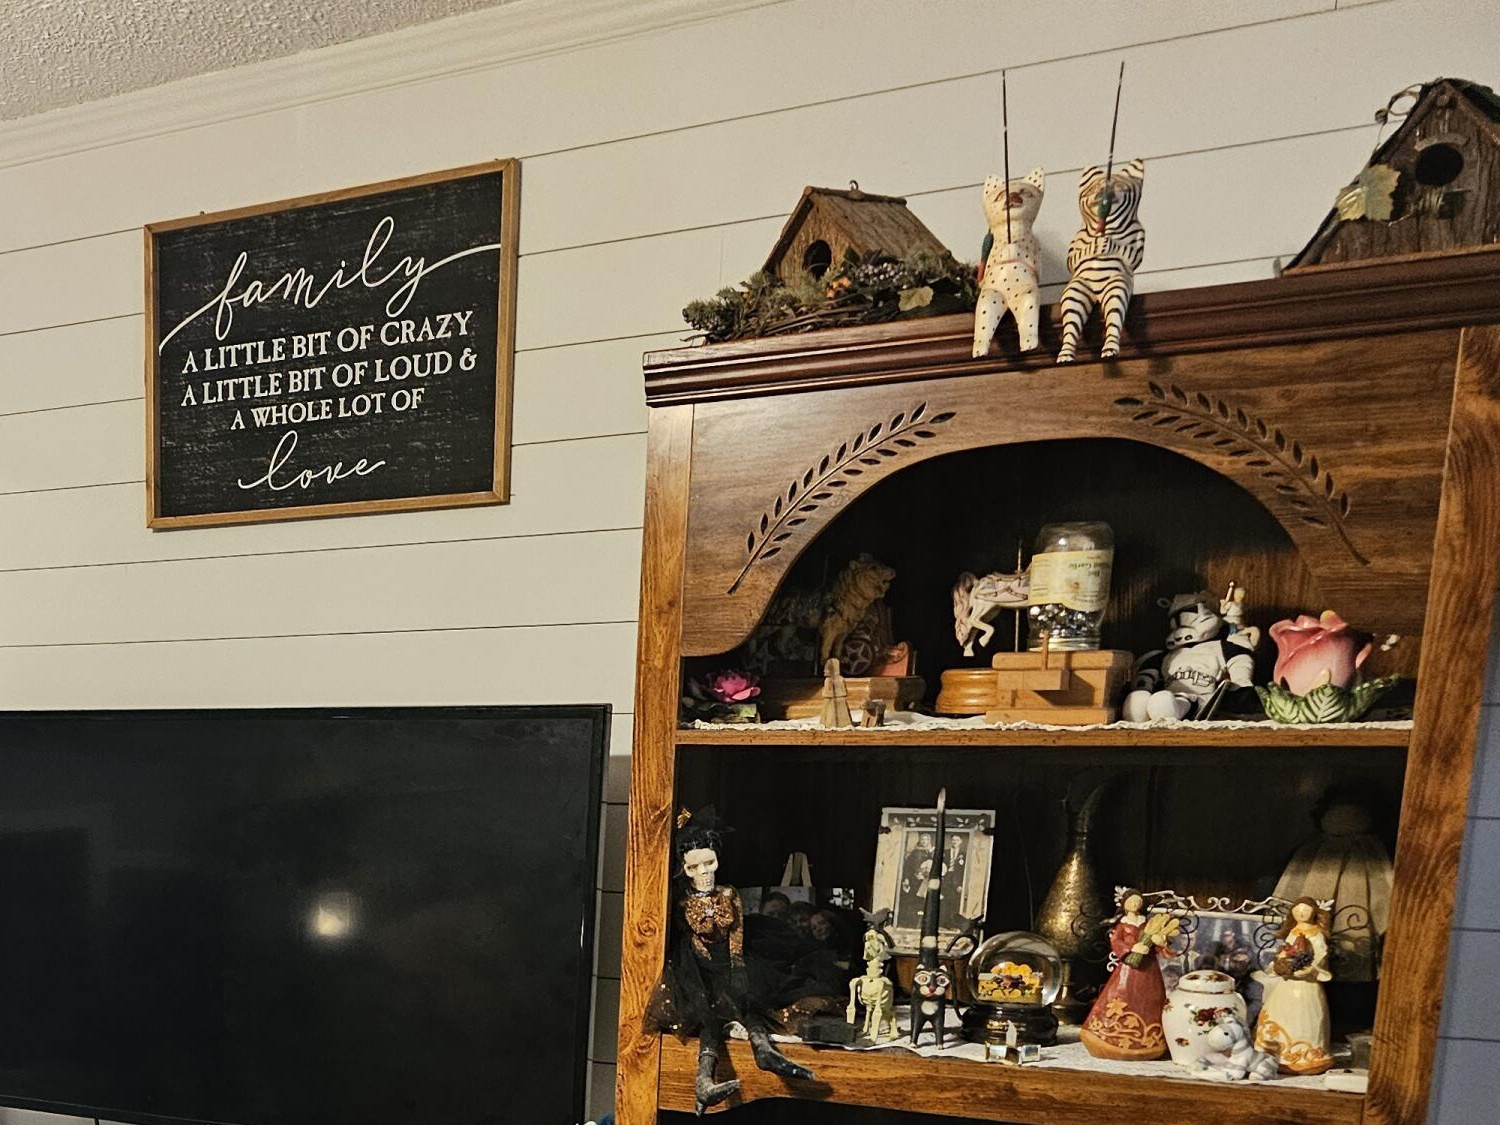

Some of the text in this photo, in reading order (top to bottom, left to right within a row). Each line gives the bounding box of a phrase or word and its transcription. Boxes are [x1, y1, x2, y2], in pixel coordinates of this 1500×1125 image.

[159, 216, 501, 356] family
[182, 310, 474, 374] A LITTLE BIT OF CRAZY
[180, 347, 478, 407] A LITTLE BIT OF LOUD &
[230, 387, 425, 430] A WHOLE LOT OF
[238, 430, 387, 491] love
